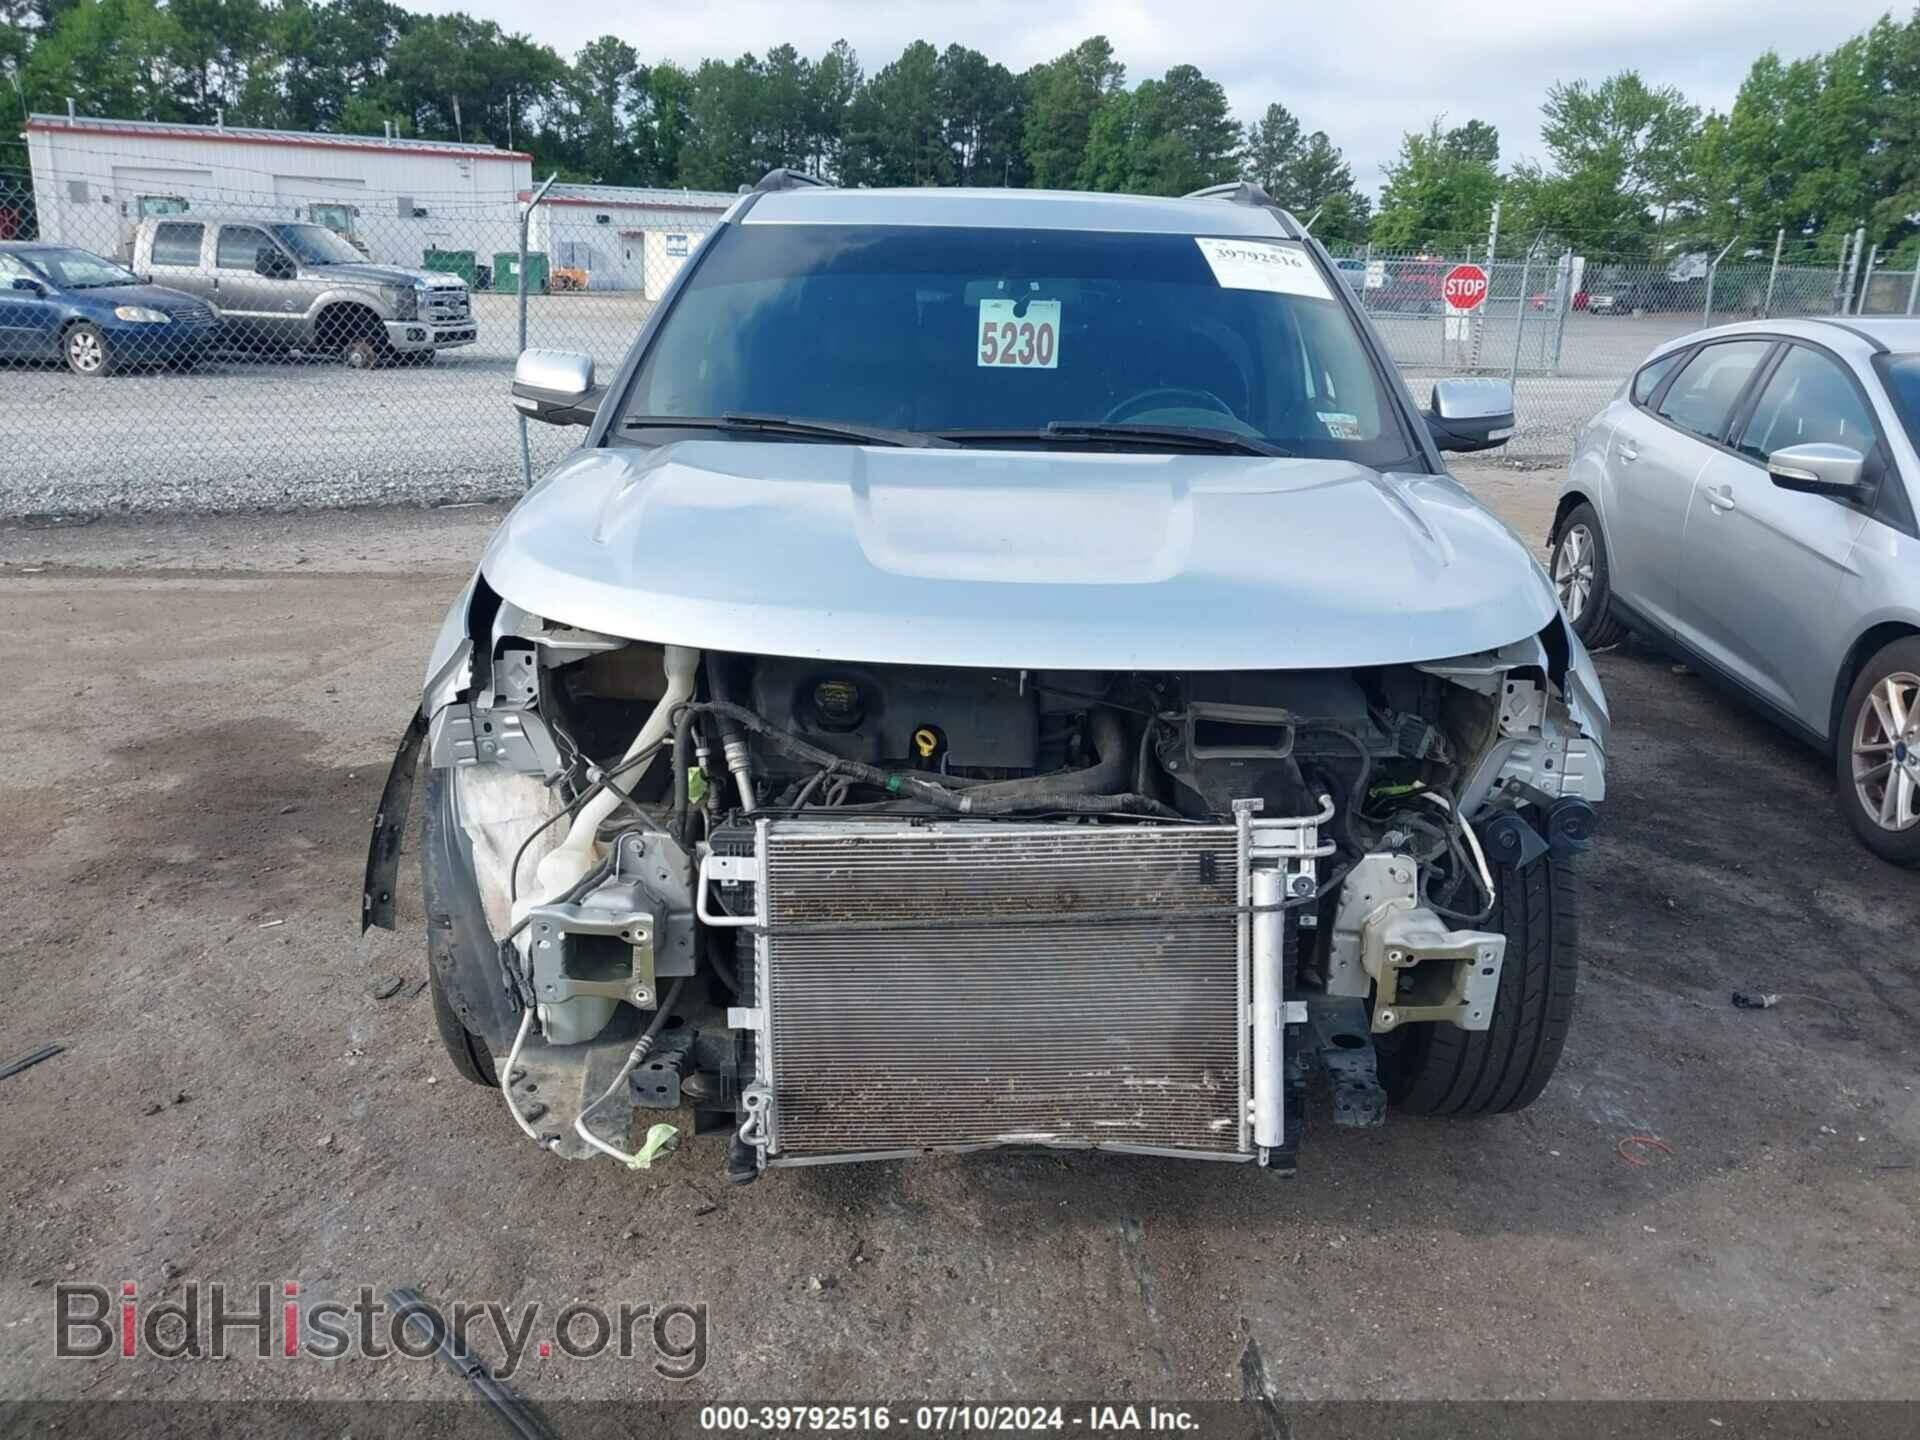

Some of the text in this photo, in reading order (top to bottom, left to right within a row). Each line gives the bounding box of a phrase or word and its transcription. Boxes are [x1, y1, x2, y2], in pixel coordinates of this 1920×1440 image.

[1215, 249, 1302, 268] 39792516
[1447, 279, 1485, 296] STOP
[981, 322, 1054, 366] 5230
